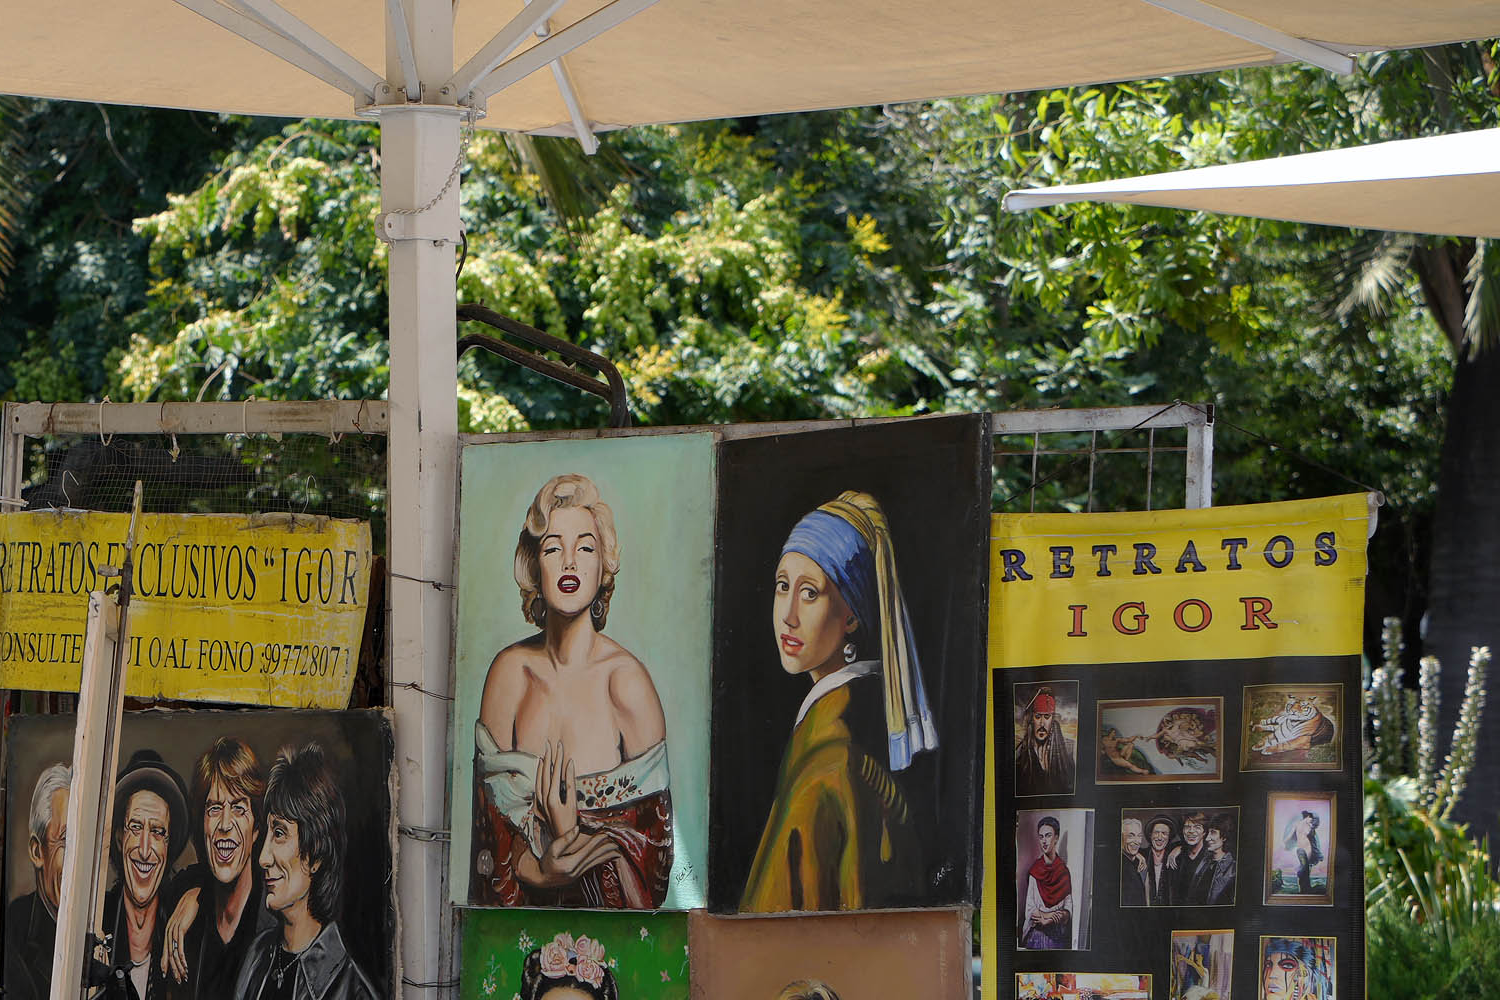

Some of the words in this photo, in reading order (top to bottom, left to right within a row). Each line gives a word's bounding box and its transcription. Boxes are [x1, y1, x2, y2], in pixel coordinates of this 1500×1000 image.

[1000, 532, 1338, 582] RETRATOS
[1067, 597, 1278, 637] IGOR
[164, 637, 193, 669] AL
[197, 639, 254, 672] FONO
